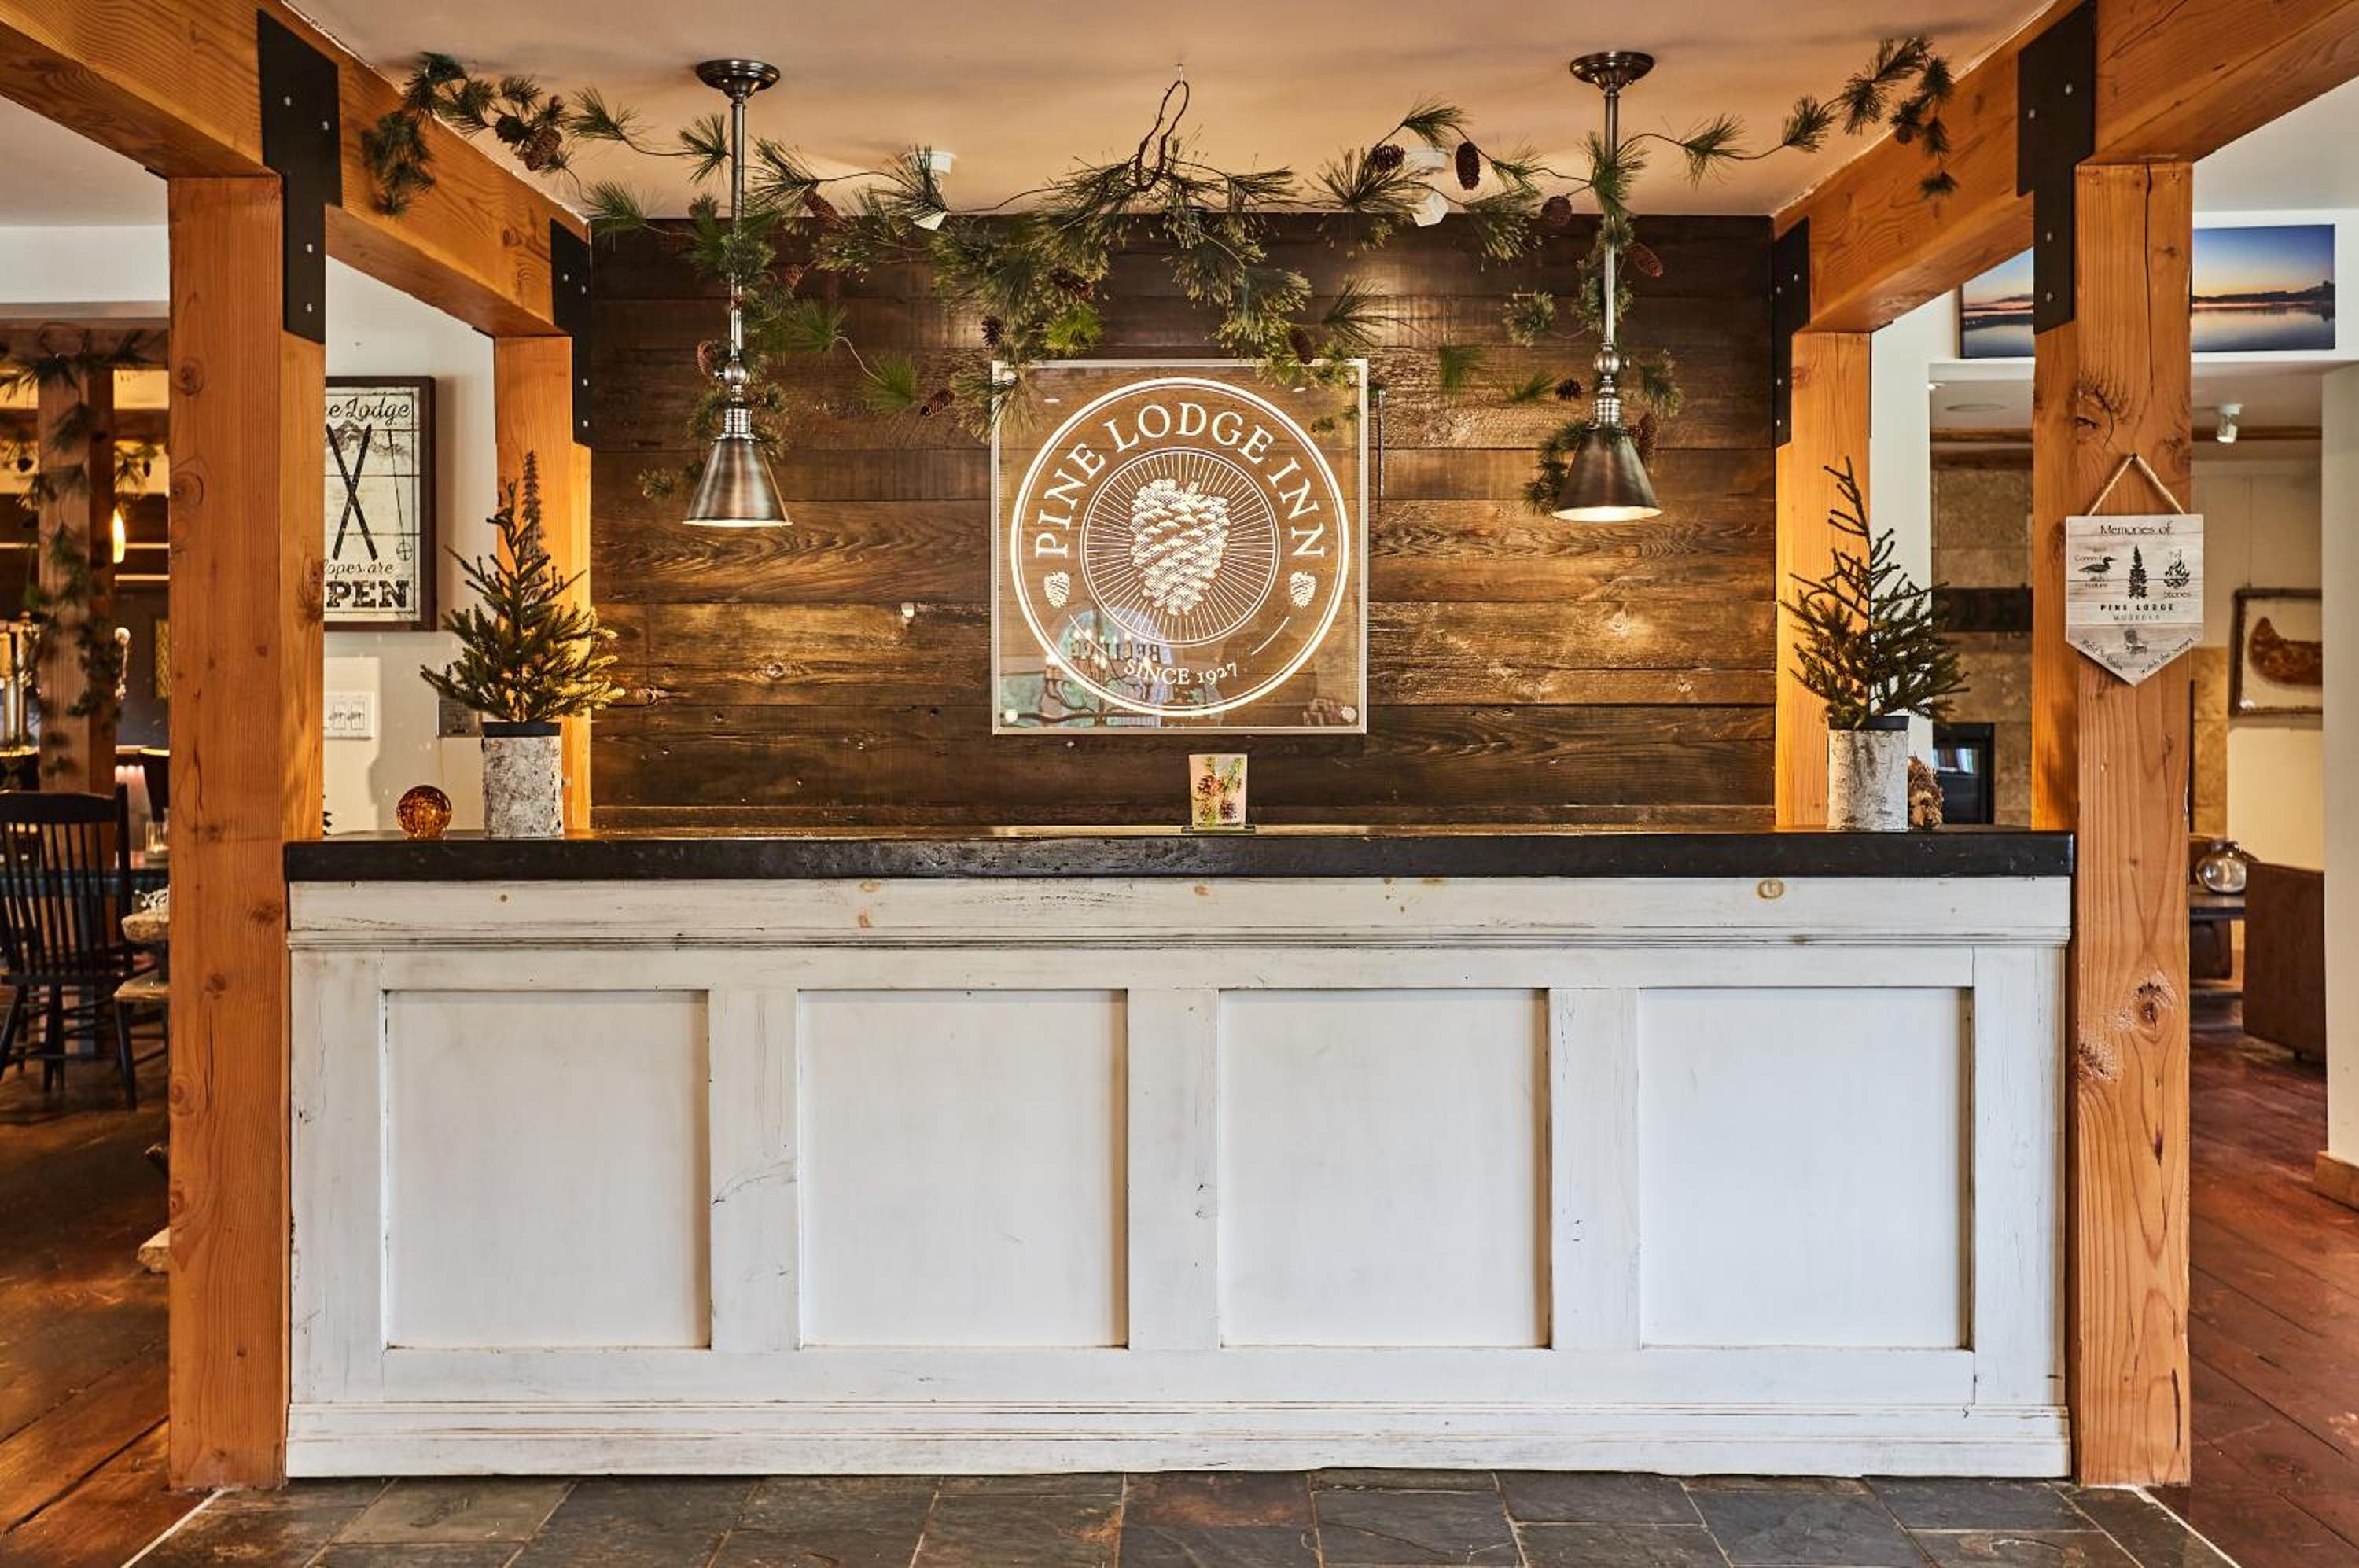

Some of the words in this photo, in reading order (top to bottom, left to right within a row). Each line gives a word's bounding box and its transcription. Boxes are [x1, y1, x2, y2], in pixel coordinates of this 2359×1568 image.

[345, 397, 410, 425] Lodge
[1036, 444, 1106, 558] PINE
[1102, 402, 1274, 463] LODGE
[1267, 458, 1326, 558] INN
[2100, 525, 2155, 536] Memories
[324, 558, 362, 580] opes
[367, 561, 394, 575] are
[326, 580, 410, 609] PEN
[1124, 659, 1190, 685] SINCE
[1197, 663, 1238, 684] 1927
